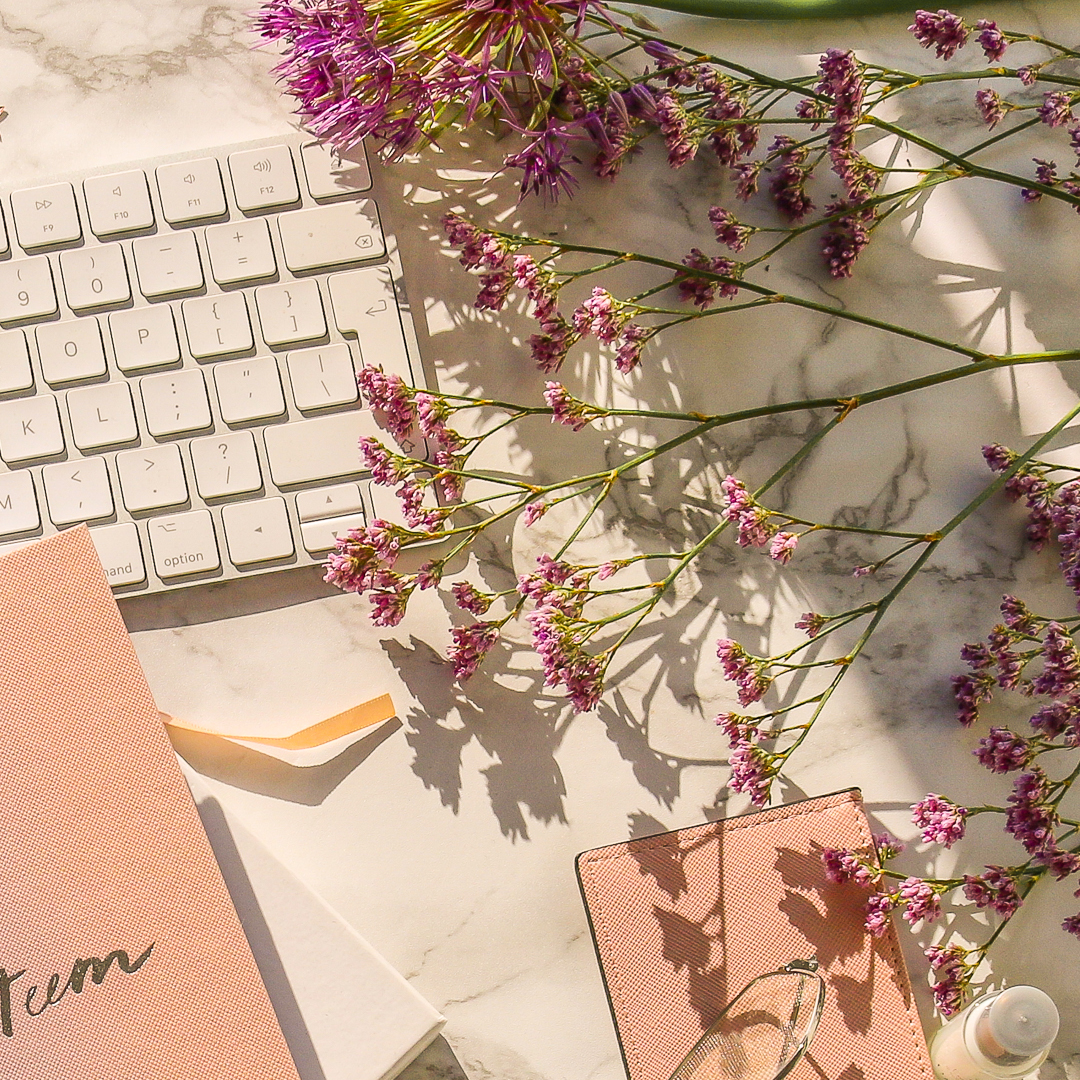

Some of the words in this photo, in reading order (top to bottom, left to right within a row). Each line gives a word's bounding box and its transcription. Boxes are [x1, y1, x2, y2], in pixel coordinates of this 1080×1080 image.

[259, 185, 275, 195] F12
[187, 198, 201, 208] F11
[113, 210, 129, 220] F10
[42, 223, 54, 233] F9
[17, 290, 30, 307] 9
[137, 328, 150, 345] P
[96, 407, 109, 423] L
[21, 418, 35, 436] K
[218, 443, 228, 460] ?
[164, 551, 204, 568] option
